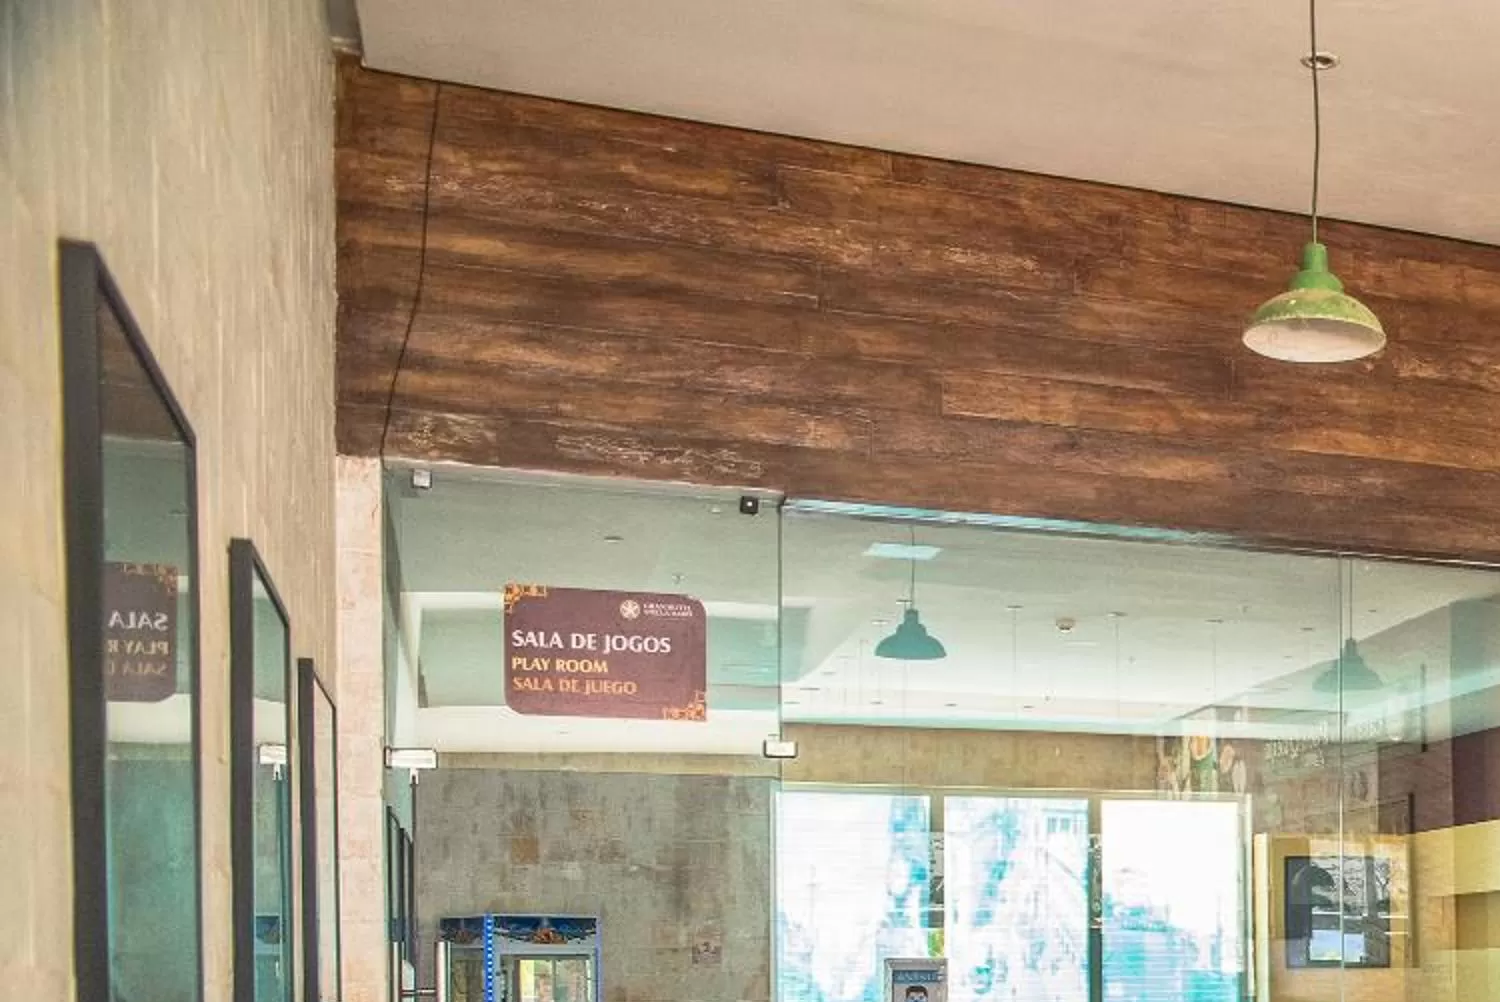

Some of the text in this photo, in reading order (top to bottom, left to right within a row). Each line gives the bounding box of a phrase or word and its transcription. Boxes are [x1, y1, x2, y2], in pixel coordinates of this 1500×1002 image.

[512, 629, 672, 654] SALA DE JOGOS
[511, 656, 609, 673] PLAY ROOM
[512, 676, 638, 695] SALA DE JUEGO
